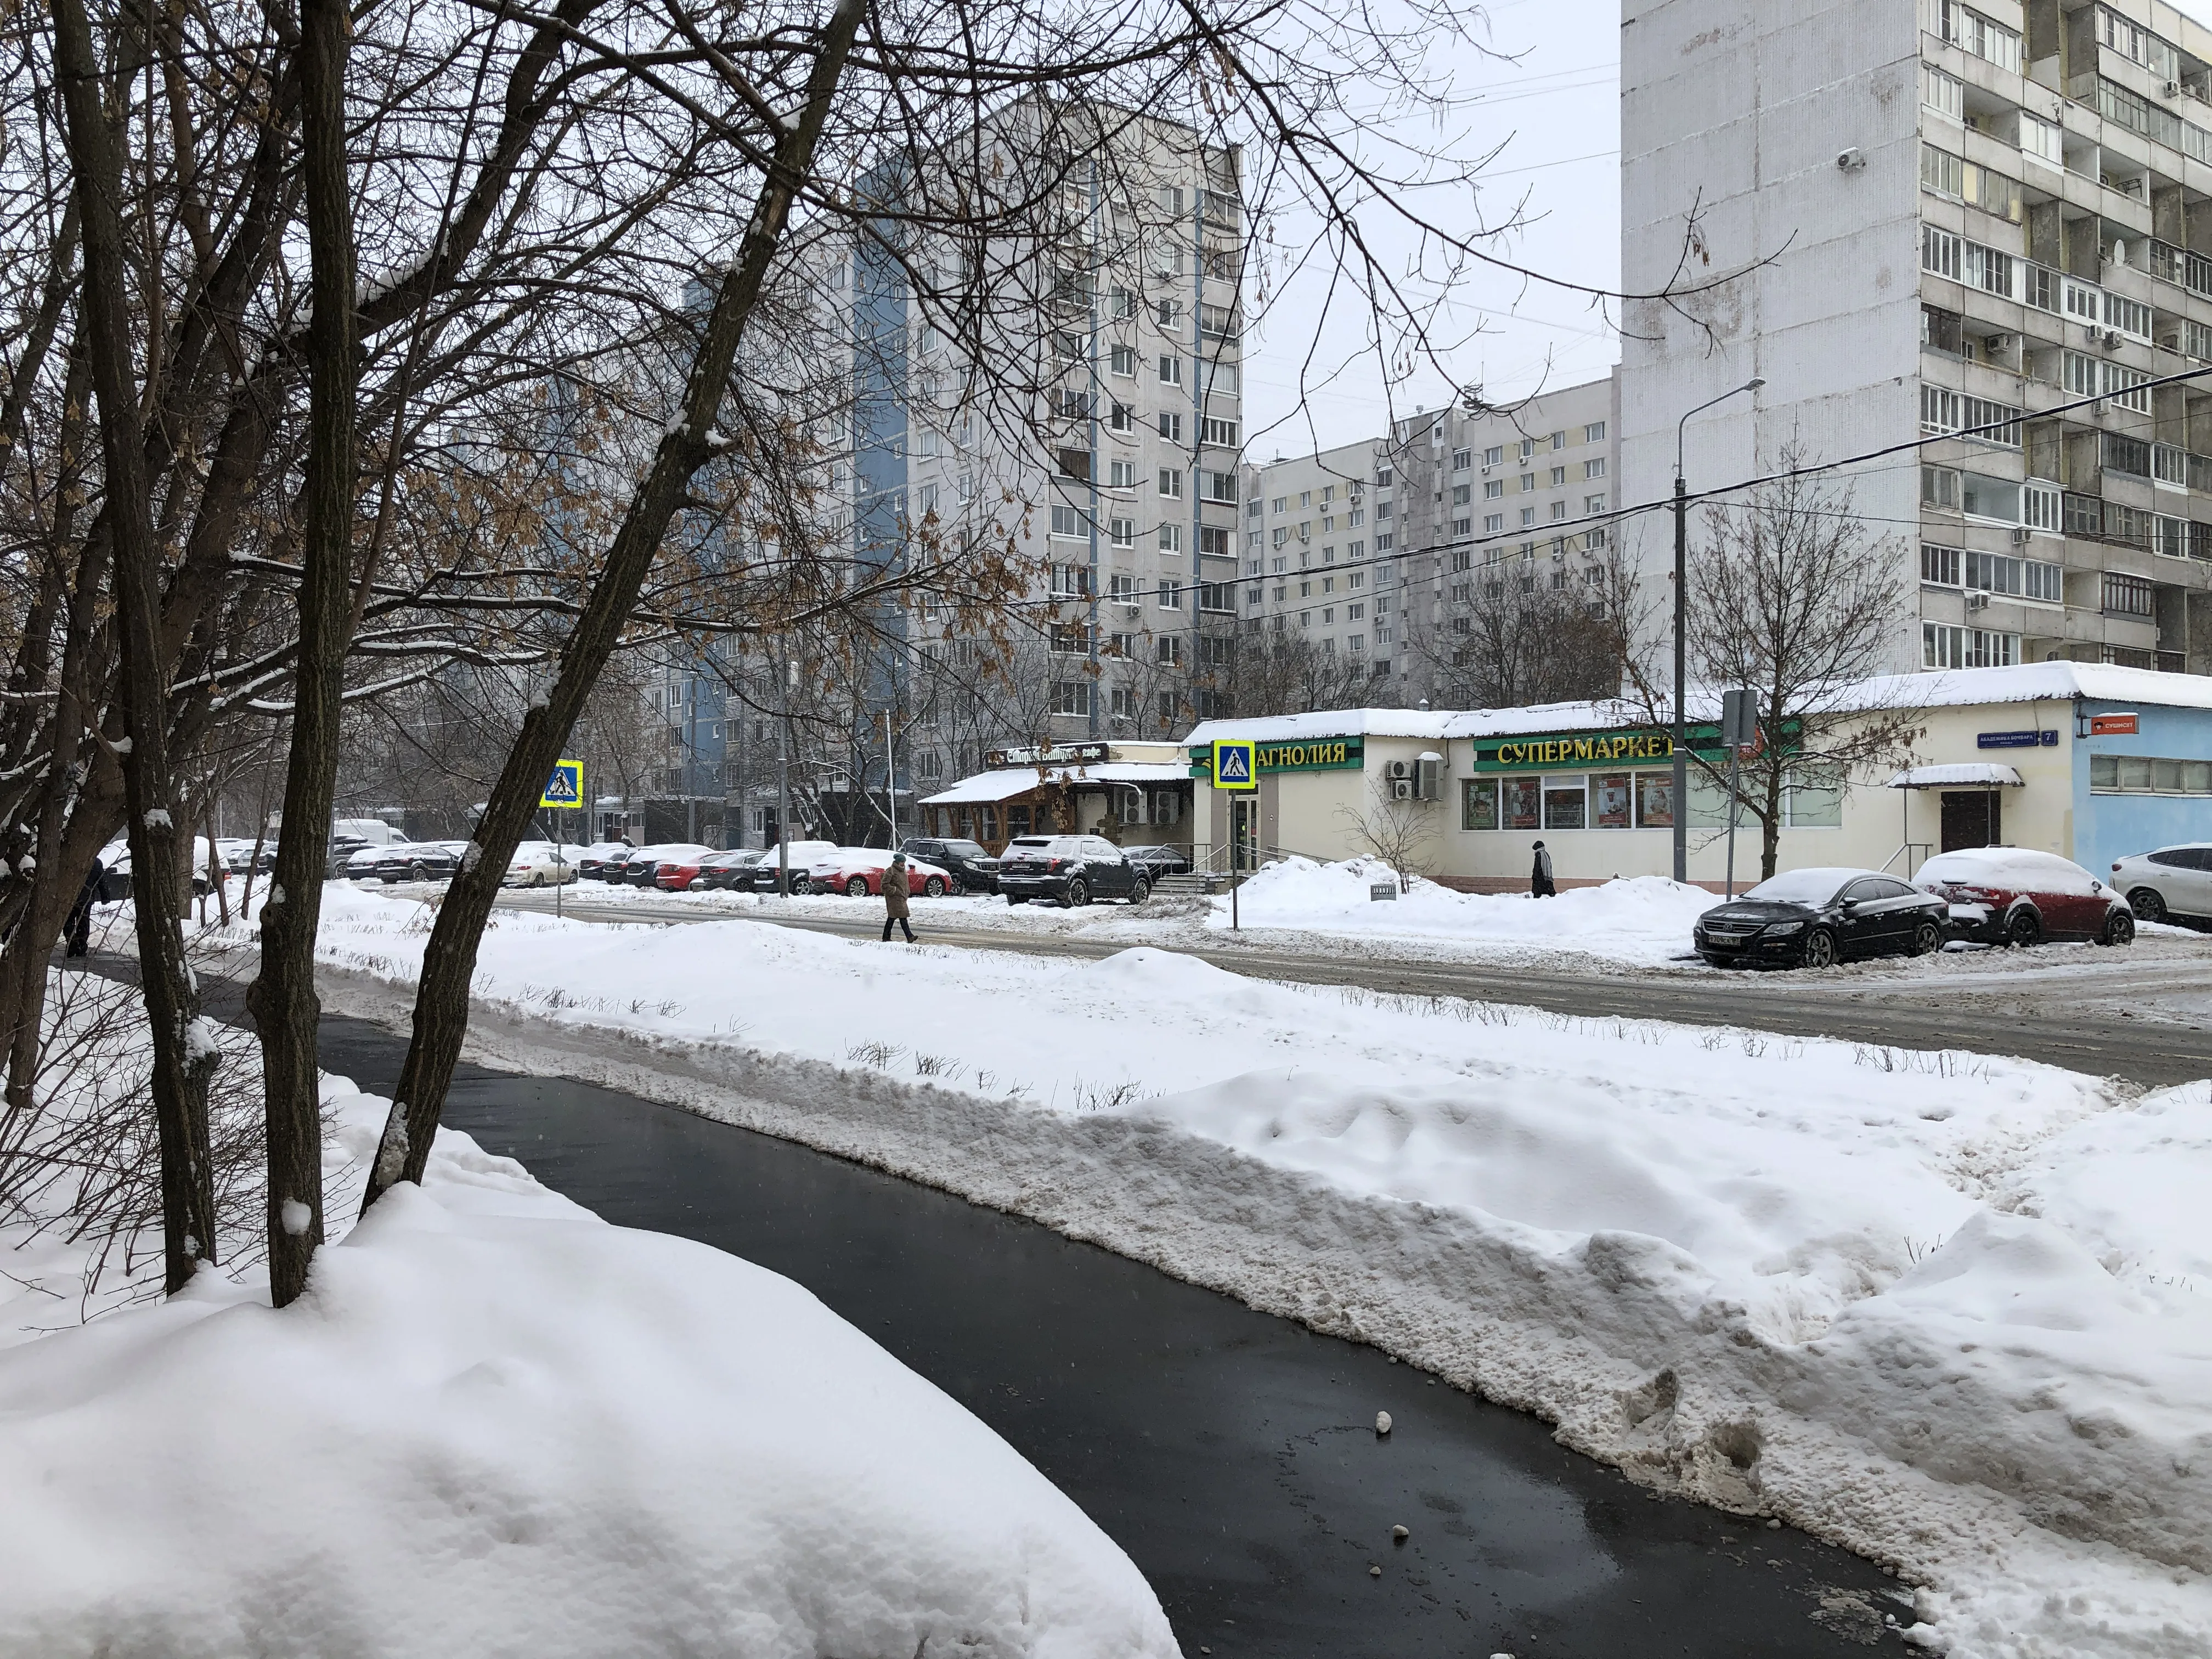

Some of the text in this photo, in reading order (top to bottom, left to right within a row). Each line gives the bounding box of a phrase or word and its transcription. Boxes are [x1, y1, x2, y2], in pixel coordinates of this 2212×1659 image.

[2045, 733, 2051, 741] 7
[1082, 747, 1102, 758] кафе
[1256, 743, 1345, 766] АГНОЛИЯ
[1498, 737, 1673, 763] СУПЕРМАРКЕТ
